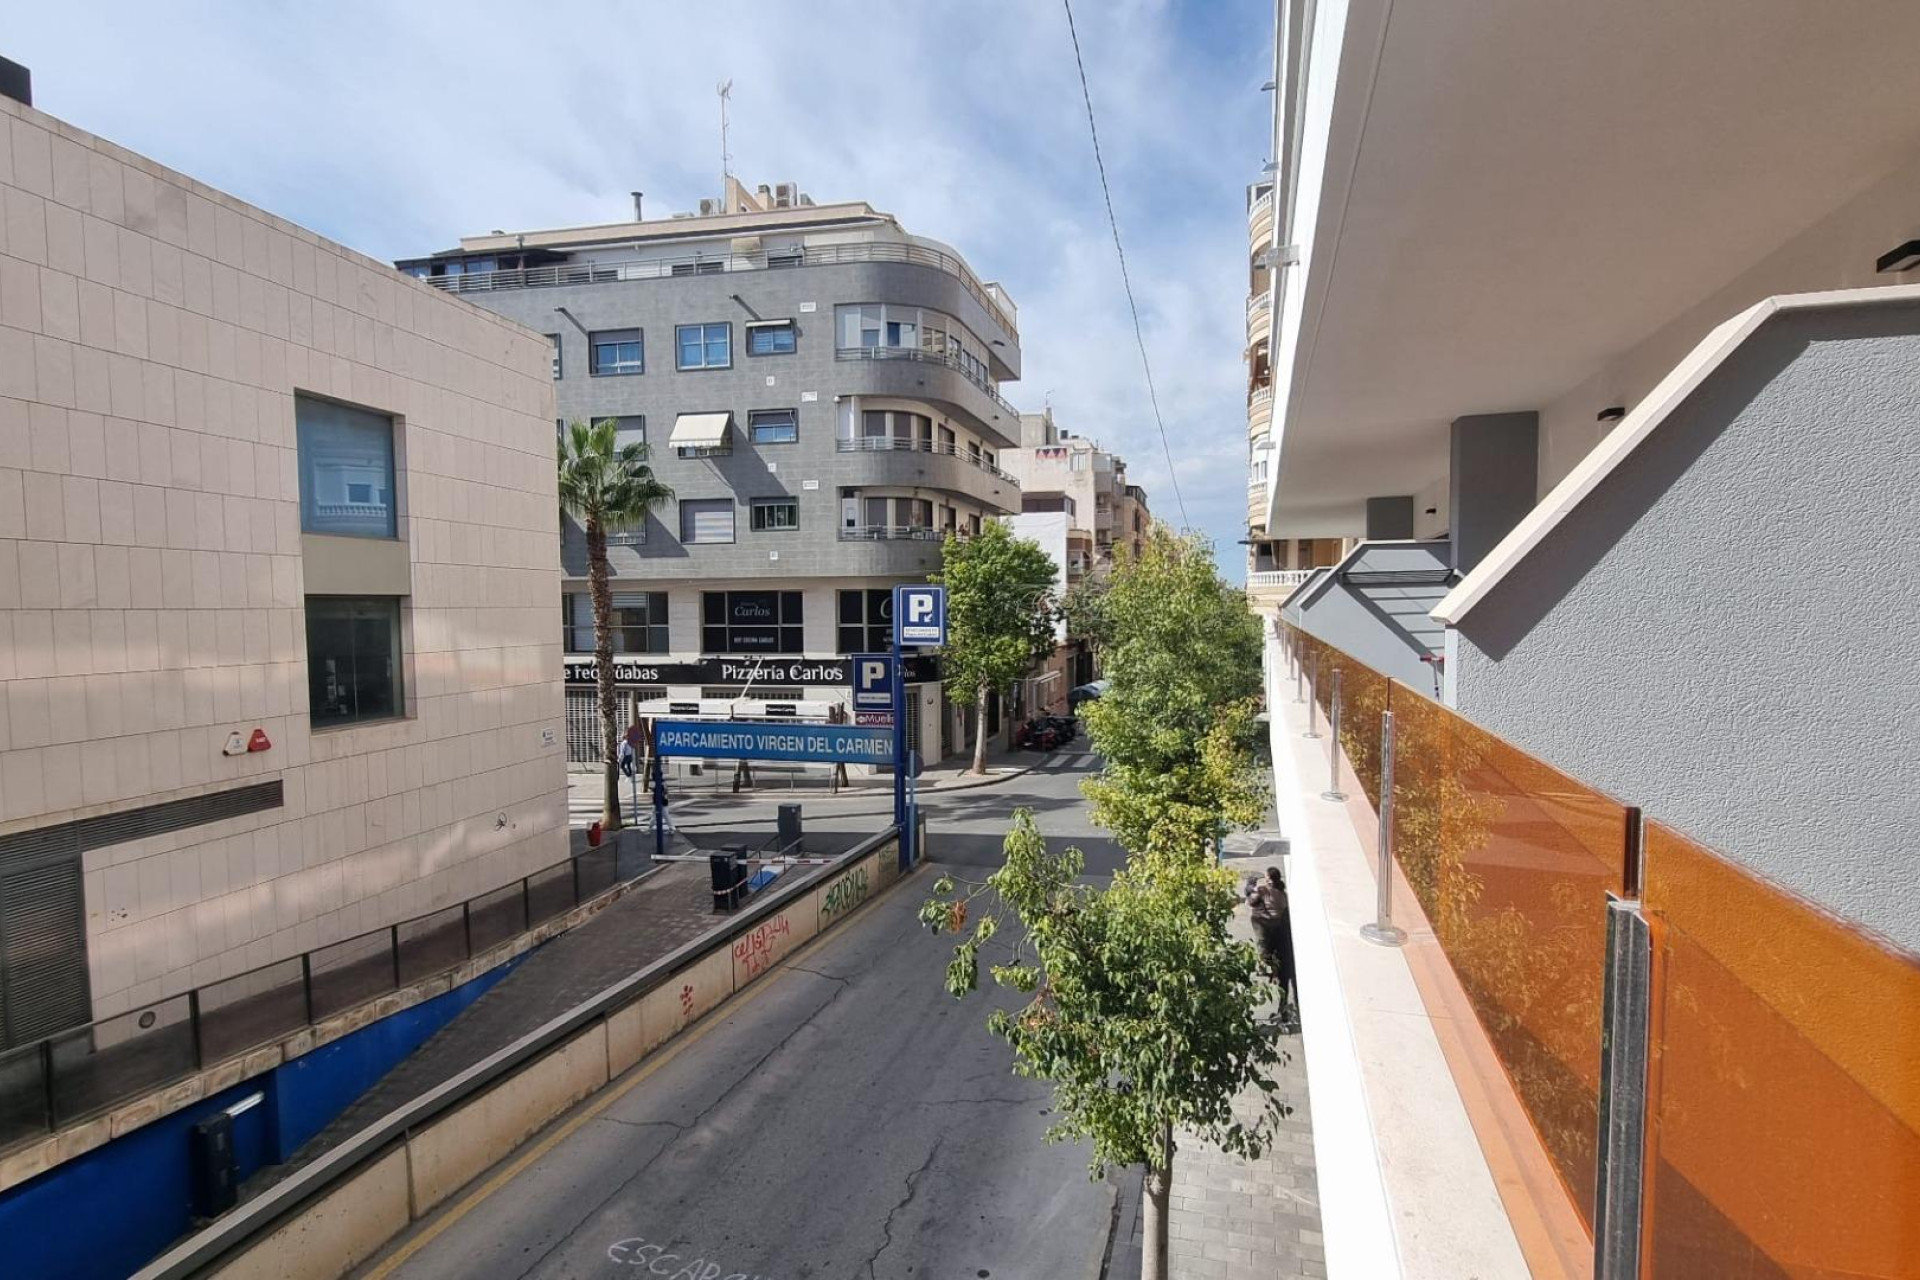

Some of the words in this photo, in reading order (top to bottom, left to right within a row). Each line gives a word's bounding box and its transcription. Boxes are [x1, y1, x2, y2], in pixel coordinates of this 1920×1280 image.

[909, 594, 933, 622] P
[789, 664, 843, 681] Carlos
[862, 661, 885, 689] P
[660, 731, 754, 750] APARCAMIENTO
[757, 735, 804, 752] VIRGEN
[807, 737, 833, 754] DEL
[836, 737, 893, 756] CARMEN
